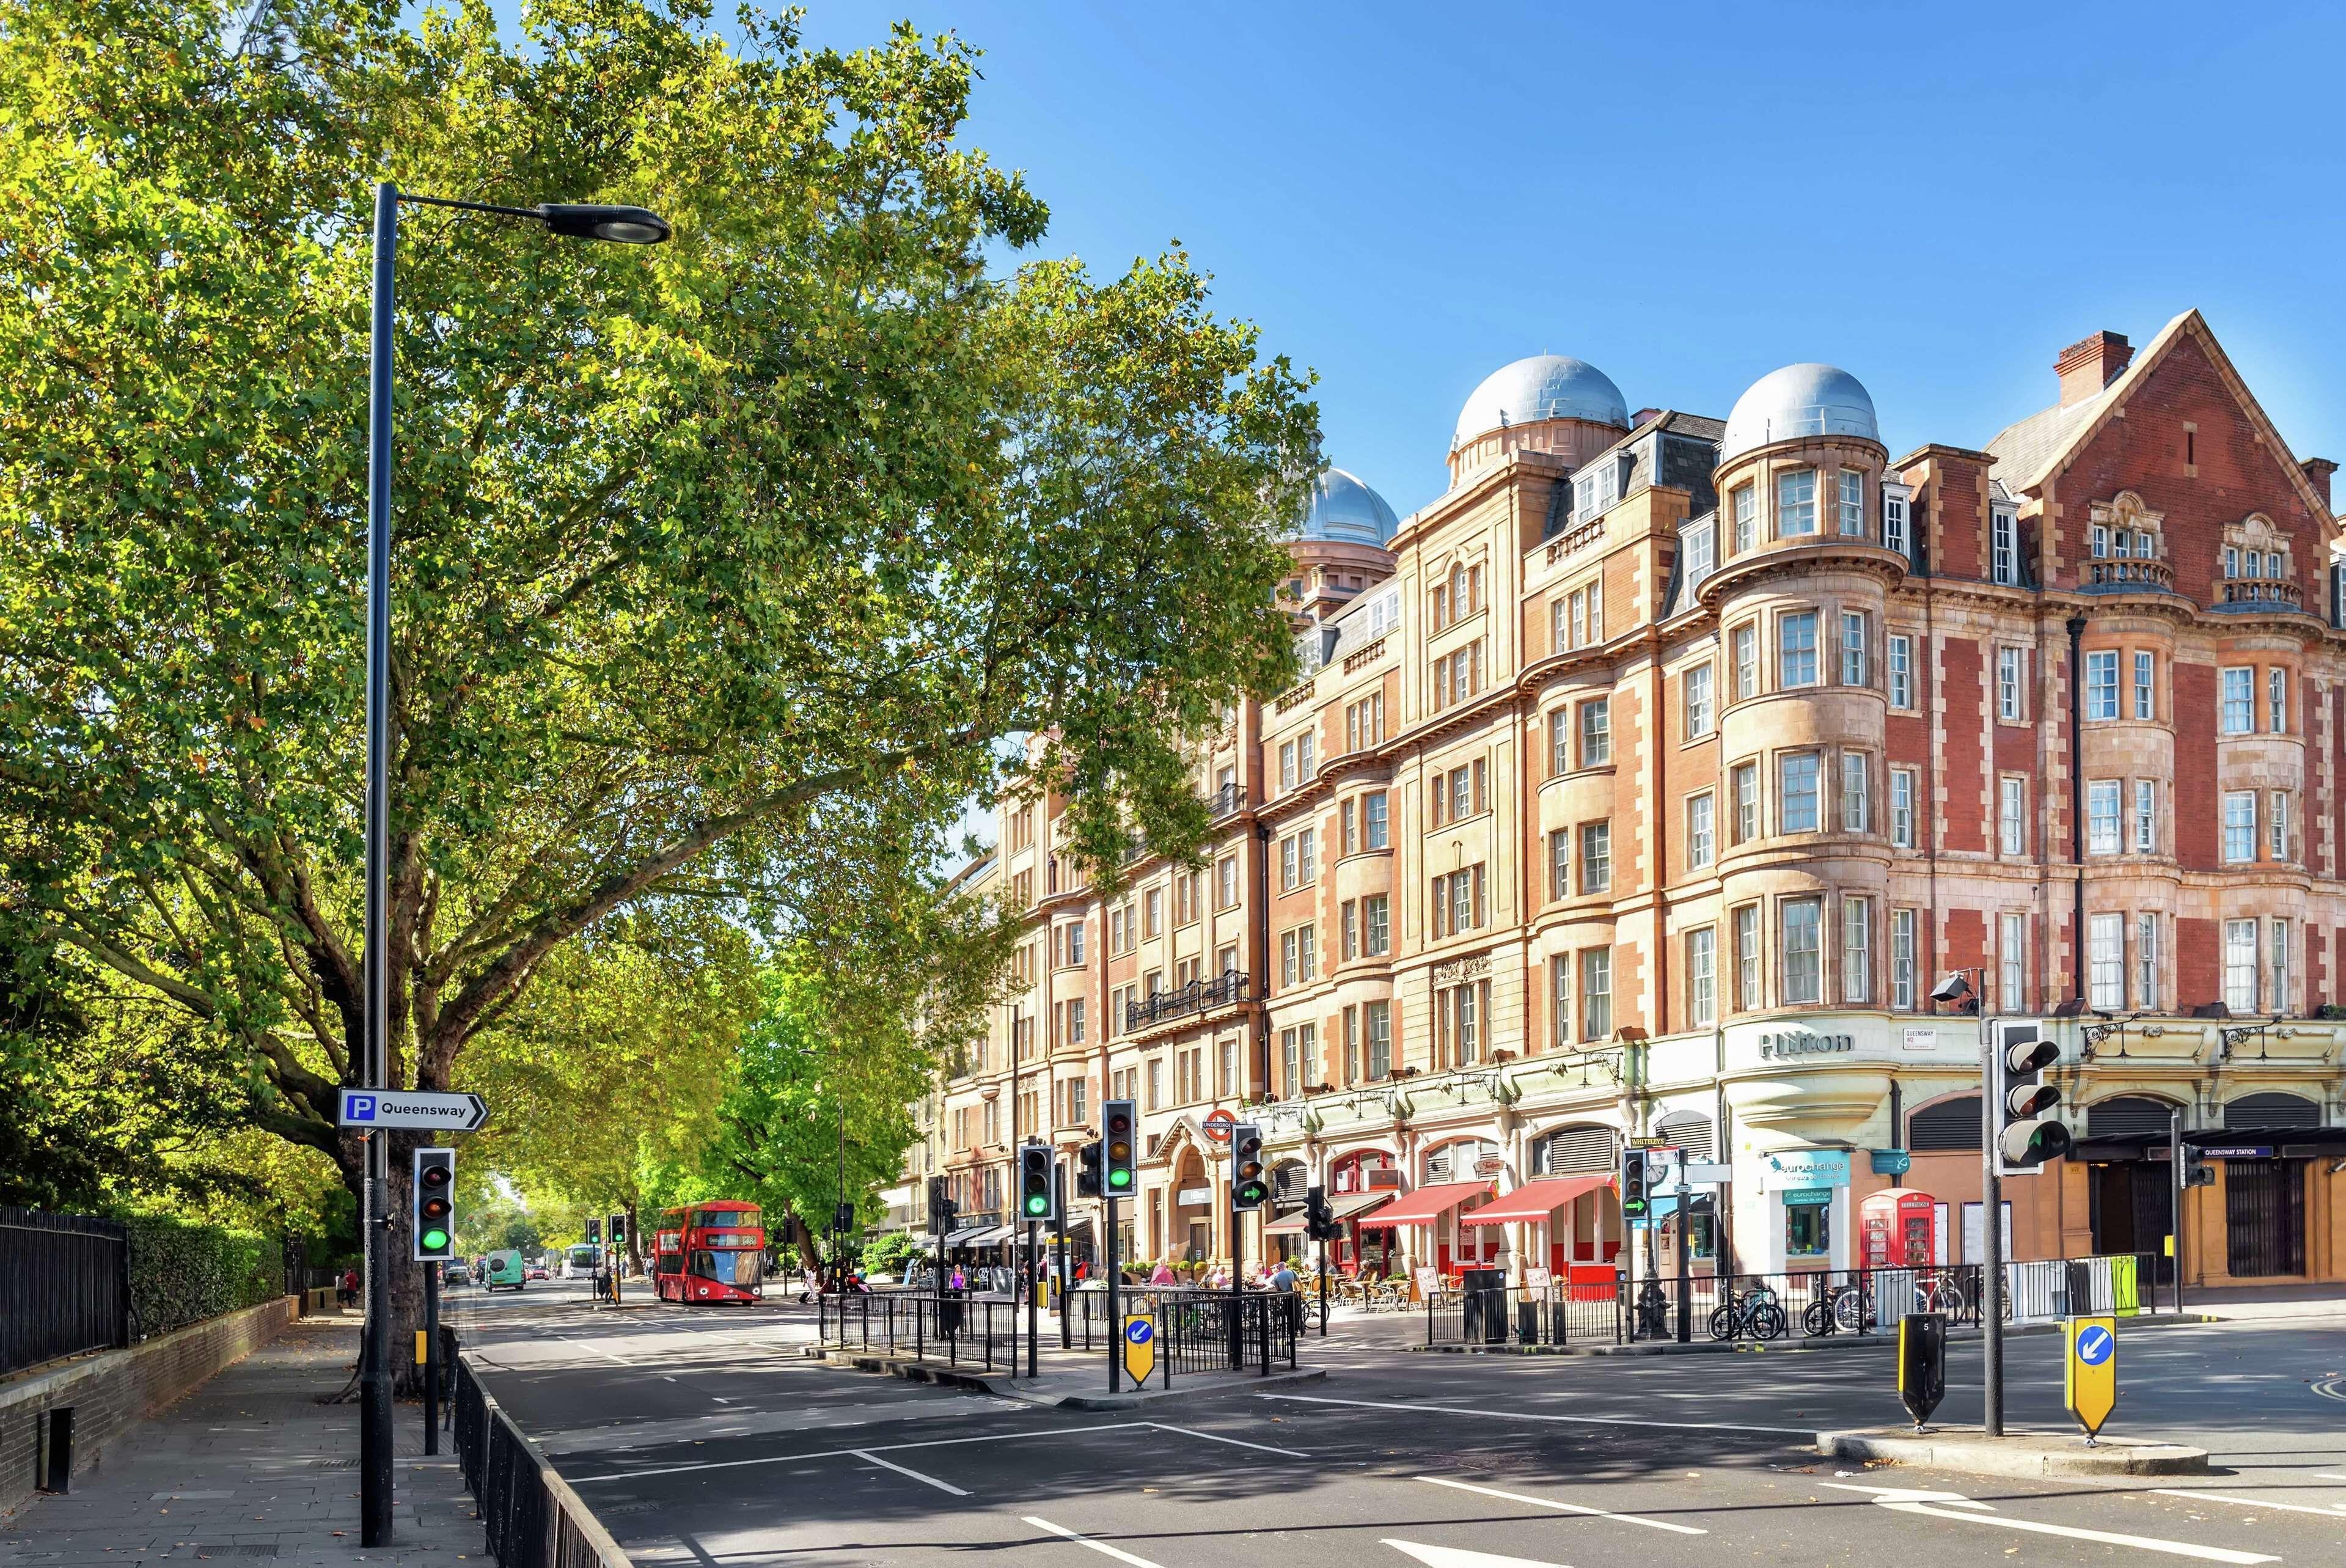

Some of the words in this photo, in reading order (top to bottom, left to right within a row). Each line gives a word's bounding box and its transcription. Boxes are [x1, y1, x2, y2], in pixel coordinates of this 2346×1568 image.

[1758, 1030, 1855, 1058] Hilton
[353, 1098, 372, 1118] P
[381, 1102, 466, 1118] Queensway
[1792, 1190, 1831, 1198] eurochange
